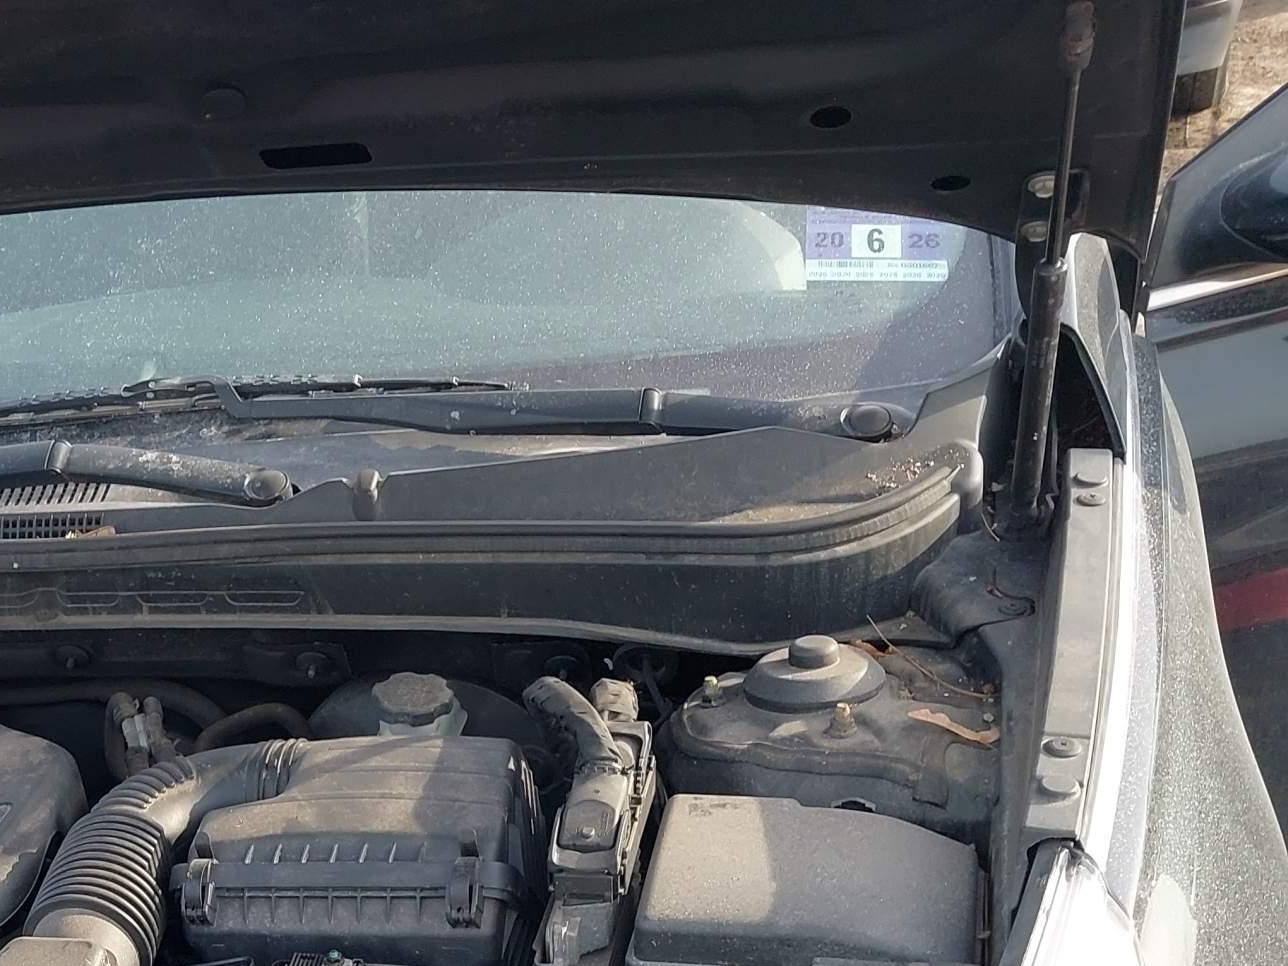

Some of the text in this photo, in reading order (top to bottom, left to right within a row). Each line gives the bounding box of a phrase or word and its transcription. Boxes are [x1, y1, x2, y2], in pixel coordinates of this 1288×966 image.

[814, 228, 941, 254] 20 6 26
